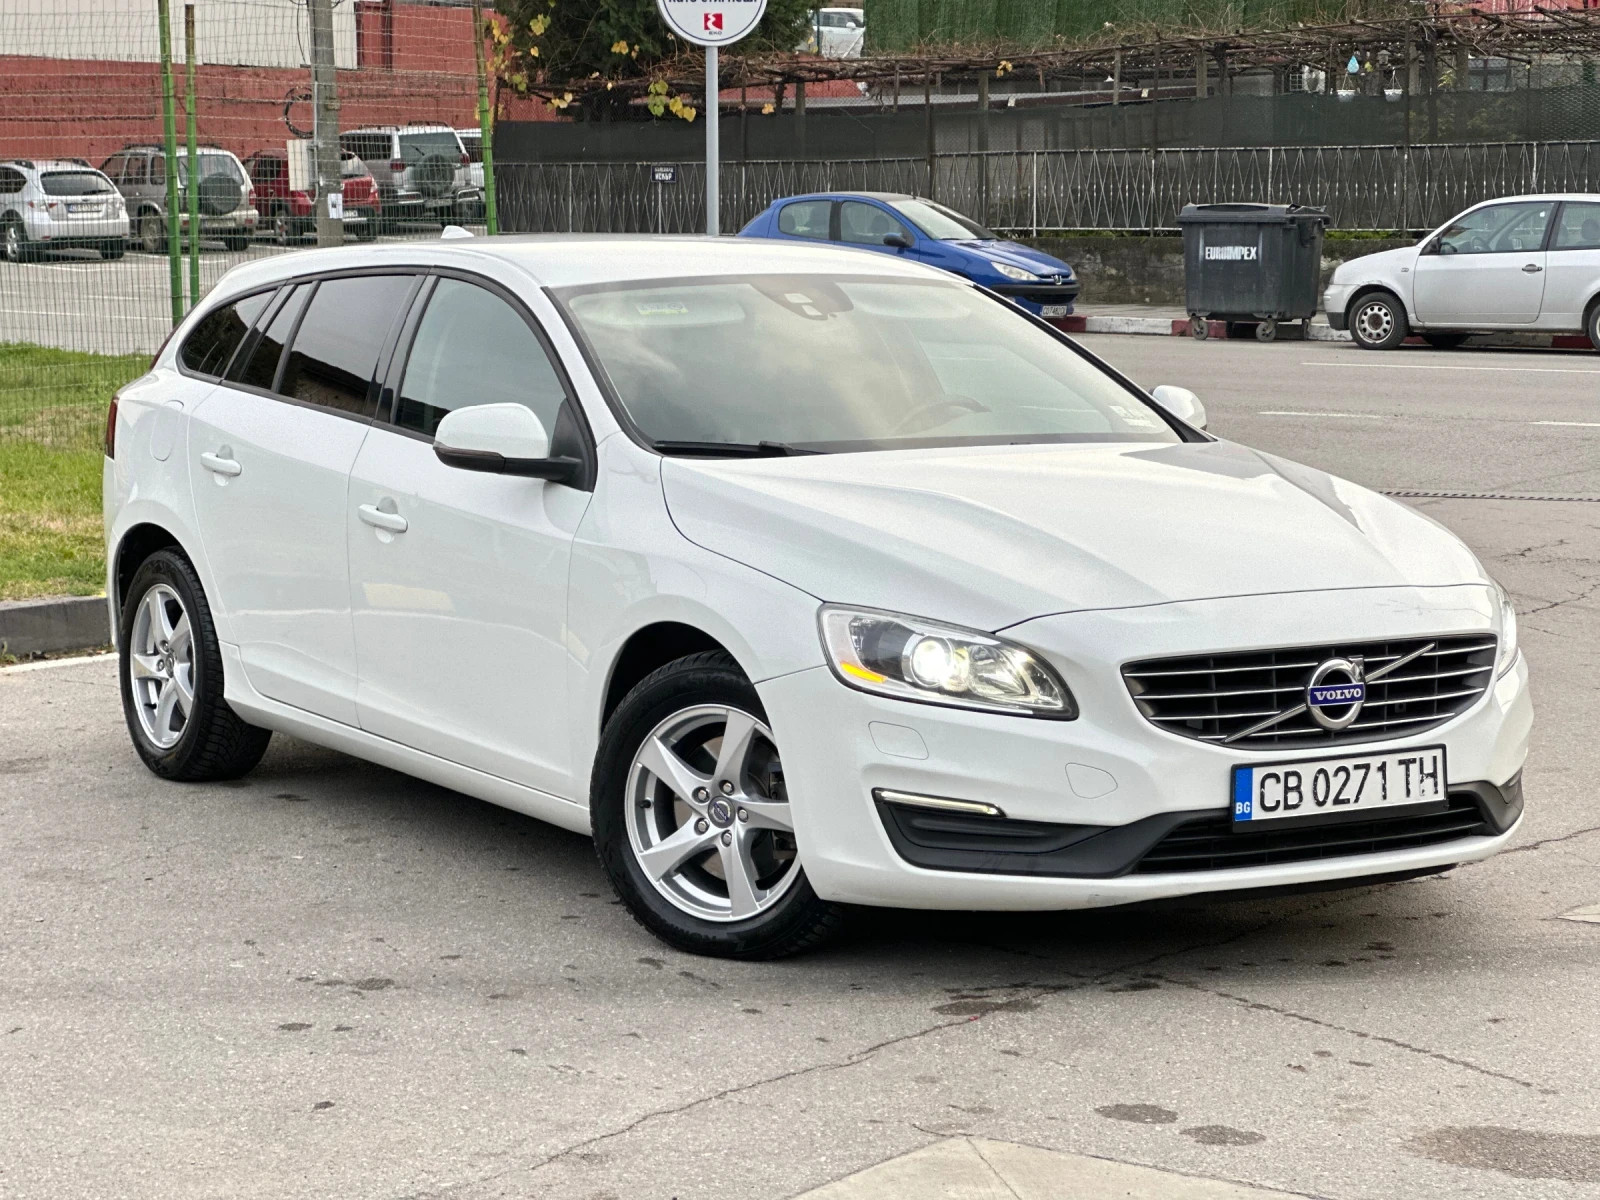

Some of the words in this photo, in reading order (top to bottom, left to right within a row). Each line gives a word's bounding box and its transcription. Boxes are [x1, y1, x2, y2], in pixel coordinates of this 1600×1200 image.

[1314, 688, 1362, 701] VOLVO
[1259, 770, 1303, 812] CB
[1312, 761, 1387, 807] 0271
[1398, 755, 1439, 798] TH
[1235, 802, 1250, 814] BG
